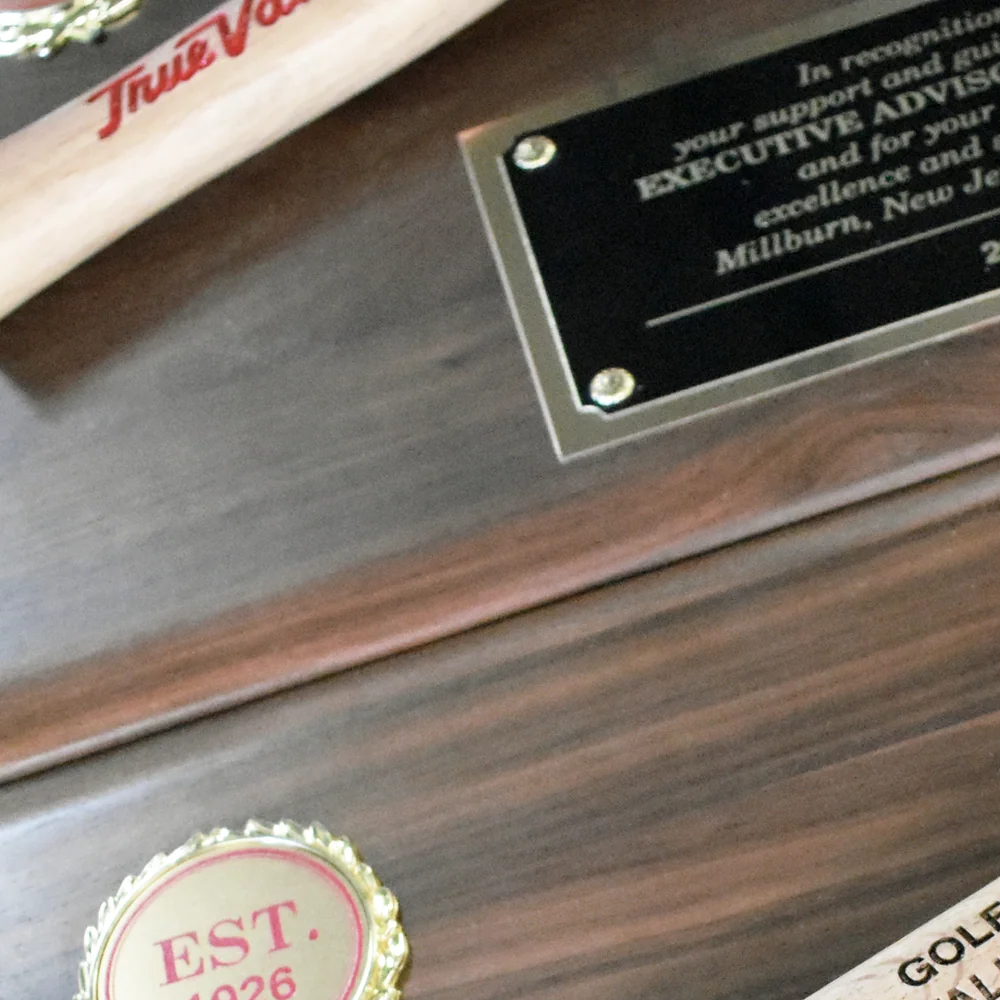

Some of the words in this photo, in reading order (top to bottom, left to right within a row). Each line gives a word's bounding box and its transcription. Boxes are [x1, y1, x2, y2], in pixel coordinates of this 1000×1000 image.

[87, 0, 311, 140] TrueVa
[672, 120, 745, 163] your
[753, 77, 873, 133] support
[881, 51, 944, 90] and
[798, 62, 832, 88] In
[634, 109, 865, 201] EXECUTIVE
[753, 165, 911, 229] excellence
[919, 135, 985, 174] and
[797, 141, 863, 181] and
[870, 130, 916, 163] for
[919, 104, 996, 146] your
[714, 213, 873, 276] Millburn,
[881, 185, 955, 222] New
[153, 899, 319, 987] EST.
